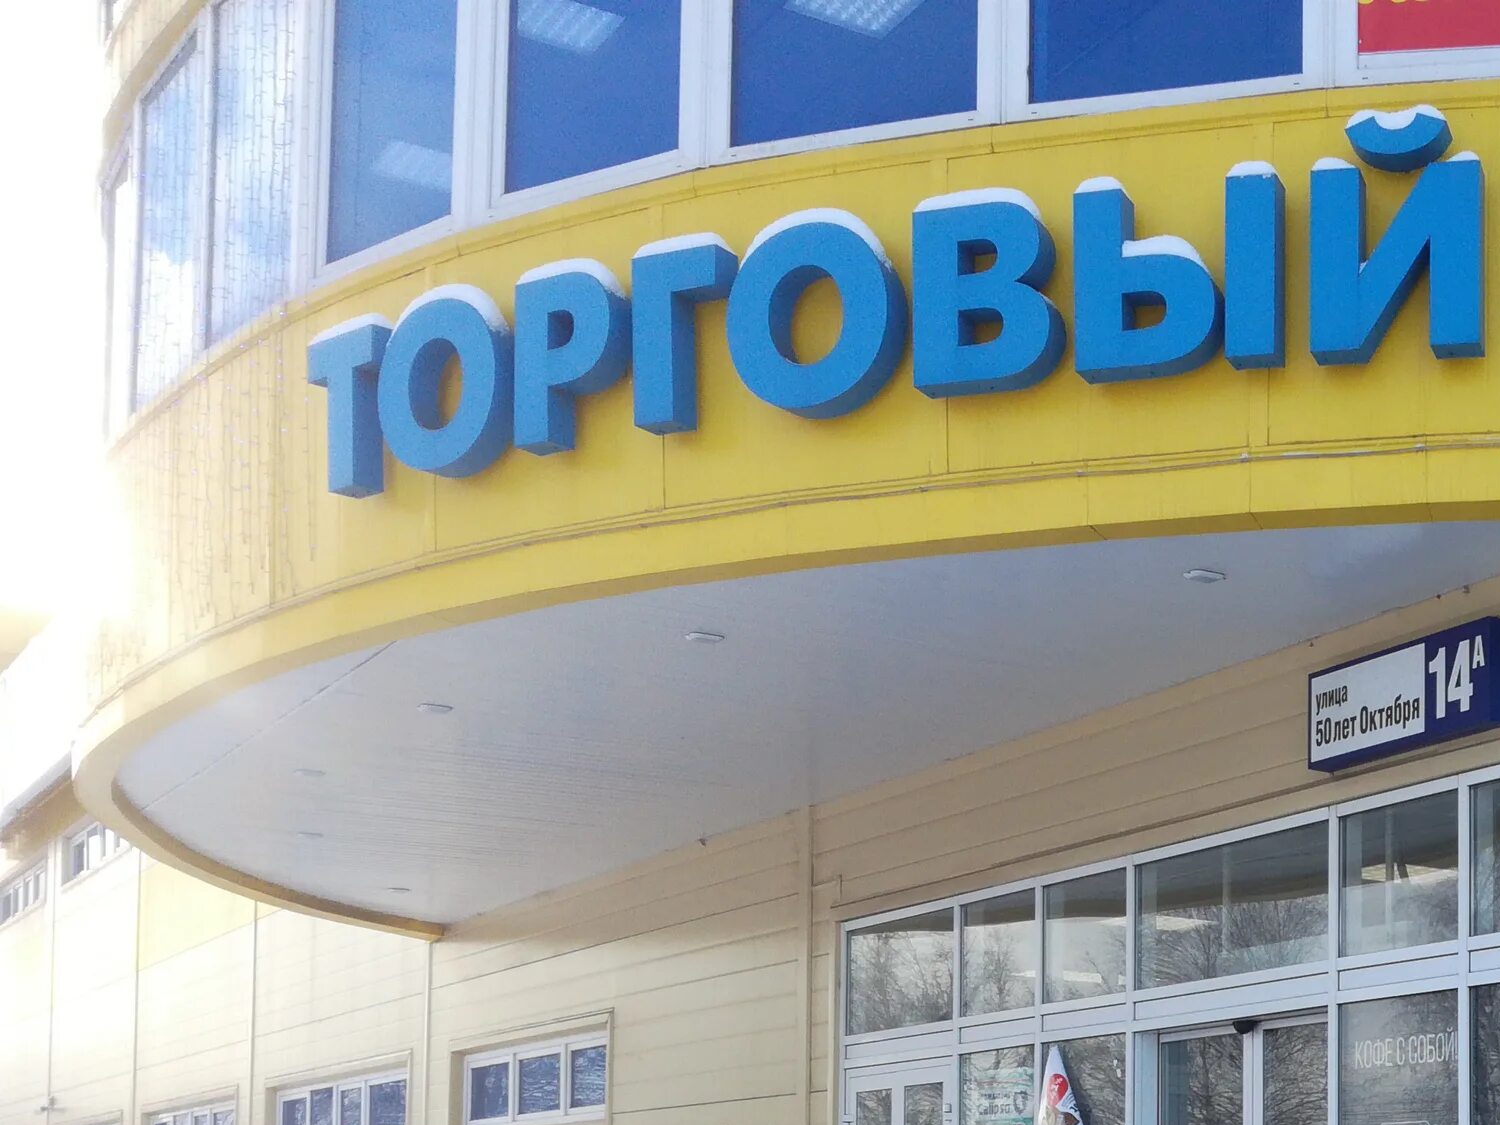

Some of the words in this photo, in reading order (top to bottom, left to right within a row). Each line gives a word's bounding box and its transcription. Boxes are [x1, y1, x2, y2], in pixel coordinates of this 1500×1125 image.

[307, 105, 1485, 499] ТОРГОВЫЙ
[1315, 684, 1348, 716] улица
[1315, 717, 1332, 747] 50
[1333, 715, 1357, 743] лет
[1359, 694, 1421, 734] Октября
[1354, 1038, 1394, 1070] КОФЕ
[1396, 1036, 1406, 1066] С
